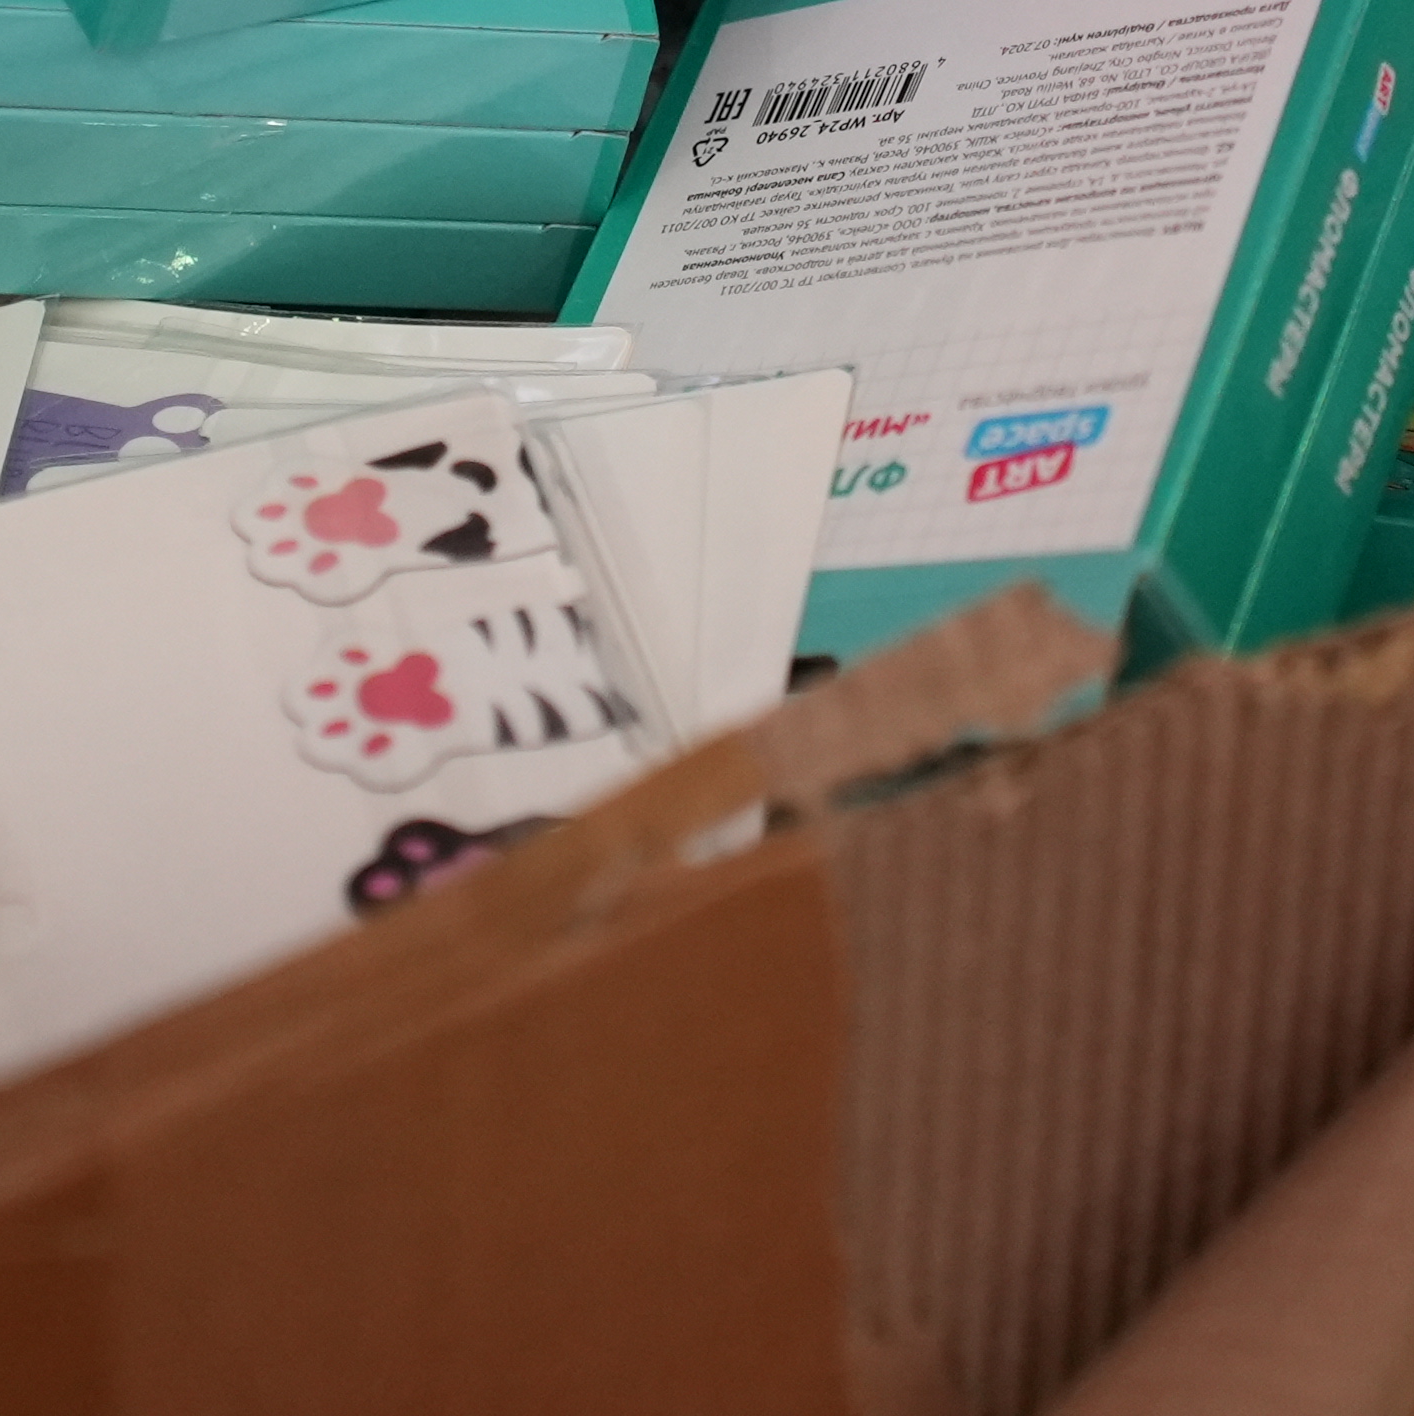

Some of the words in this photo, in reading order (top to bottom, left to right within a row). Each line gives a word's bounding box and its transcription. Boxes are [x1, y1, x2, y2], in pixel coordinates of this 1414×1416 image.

[871, 109, 906, 124] Арт.
[756, 115, 867, 145] WP24_26940
[680, 249, 787, 273] Уполномоченная
[648, 272, 714, 291] безопасен
[714, 268, 750, 282] Товар
[969, 450, 1070, 498] ART
